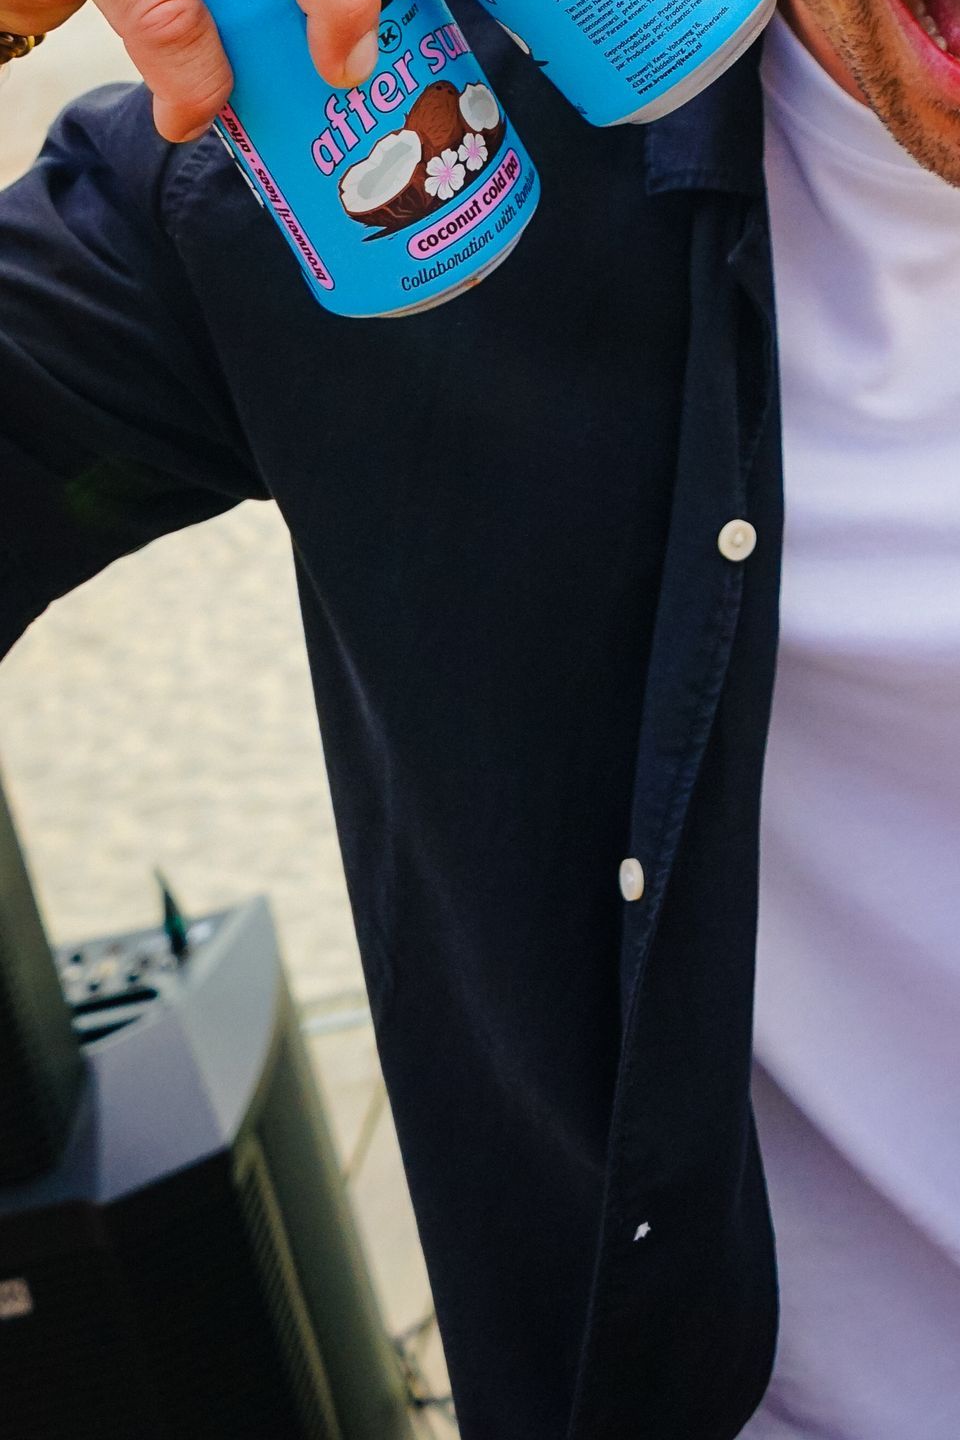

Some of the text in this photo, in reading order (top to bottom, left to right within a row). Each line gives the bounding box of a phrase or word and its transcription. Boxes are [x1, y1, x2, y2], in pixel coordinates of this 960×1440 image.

[582, 7, 614, 34] consommer
[615, 0, 625, 8] de
[603, 24, 643, 58] Geproduceerd
[684, 37, 697, 48] The
[625, 61, 653, 83] Brouwerij
[666, 28, 694, 52] Voltaweg
[636, 41, 703, 95] www.brouwerijkees.nl
[311, 49, 419, 176] after
[222, 113, 326, 282] brouwerij kees after
[417, 155, 518, 252] coconut cold ipa
[401, 230, 494, 291] Collaboration
[495, 204, 516, 233] with
